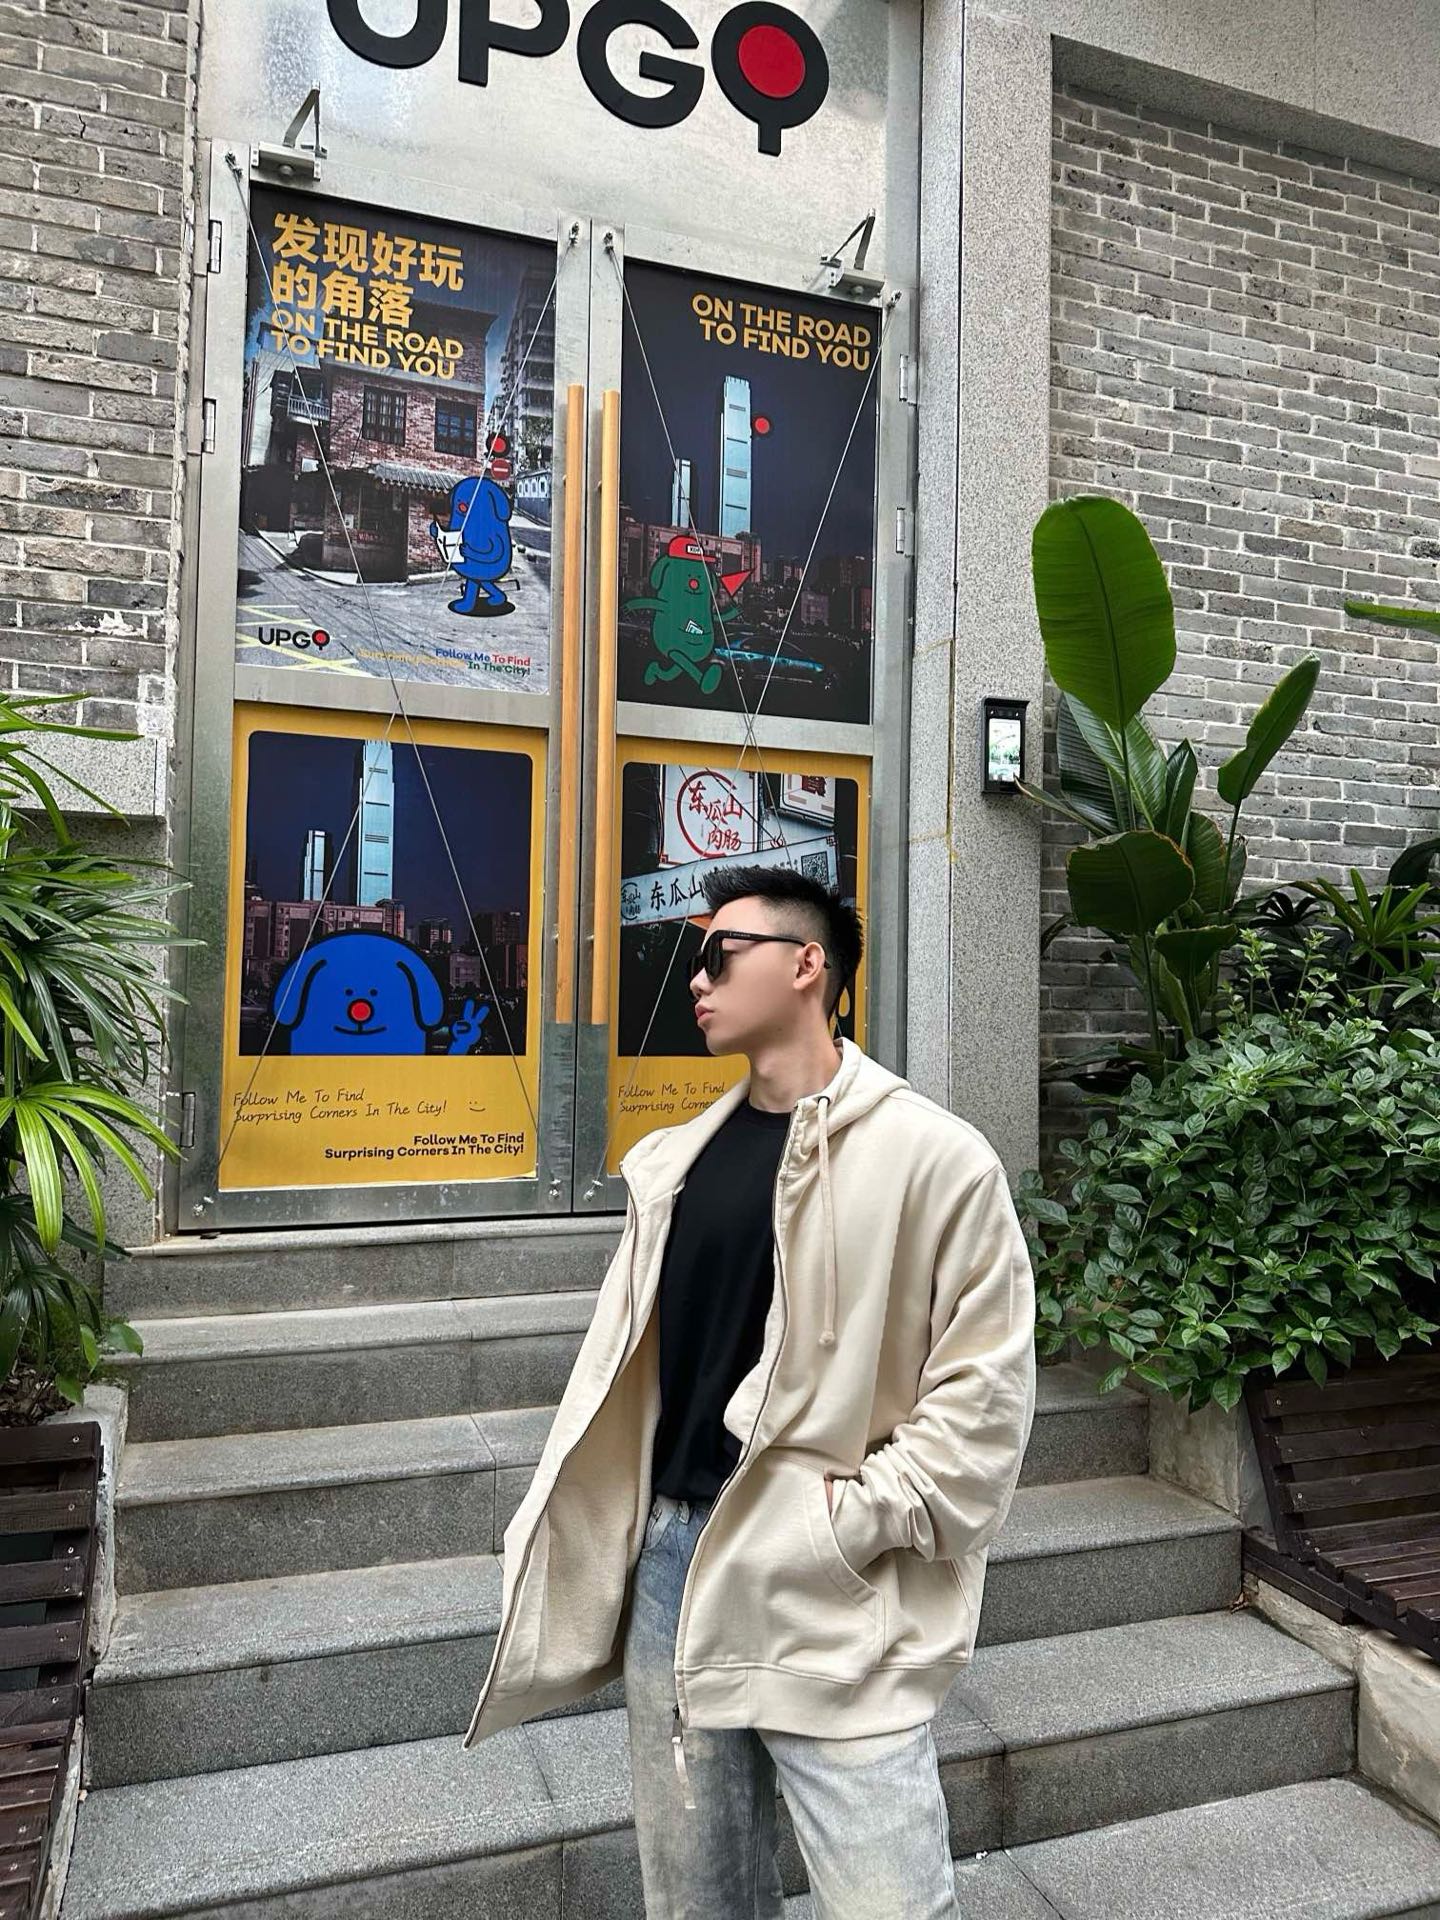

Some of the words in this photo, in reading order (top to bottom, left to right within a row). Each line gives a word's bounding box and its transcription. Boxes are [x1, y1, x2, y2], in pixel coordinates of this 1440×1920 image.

[271, 213, 465, 291] 发现好玩
[271, 260, 414, 328] 的角落
[692, 294, 733, 321] ON
[740, 303, 792, 333] THE
[798, 315, 871, 347] ROAD
[271, 309, 316, 335] ON
[323, 317, 379, 345] THE
[386, 329, 464, 359] ROAD
[699, 318, 737, 345] TO
[743, 327, 810, 359] FIND
[816, 342, 870, 371] YOU
[270, 330, 311, 355] TO
[317, 338, 391, 369] FIND
[398, 352, 456, 379] YOU
[435, 648, 472, 661] Follow
[474, 653, 490, 662] Me
[492, 654, 506, 664] To
[507, 656, 531, 667] Find
[467, 661, 480, 670] In
[482, 662, 502, 672] The
[688, 780, 743, 825] 东瓜山
[708, 828, 742, 852] 肉肠
[651, 873, 705, 911] 东瓜山
[233, 1091, 279, 1106] Follow
[286, 1090, 307, 1103] Me
[315, 1088, 330, 1103] To
[337, 1088, 365, 1102] Find
[618, 1085, 655, 1098] Follow
[661, 1083, 678, 1096] Me
[685, 1082, 697, 1094] To
[703, 1081, 725, 1094] Find
[235, 1109, 302, 1125] Surprising
[310, 1105, 357, 1119] Corners
[365, 1103, 379, 1117] In
[387, 1101, 410, 1115] The
[417, 1100, 447, 1117] City!
[620, 1100, 674, 1115] Surprising
[414, 1134, 456, 1146] Follow
[459, 1134, 477, 1145] Me
[480, 1133, 495, 1144] To
[497, 1132, 525, 1144] Find
[325, 1147, 394, 1161] Surprising
[397, 1146, 449, 1157] Corners
[451, 1145, 466, 1155] In
[468, 1144, 491, 1155] The
[494, 1143, 524, 1157] City!
